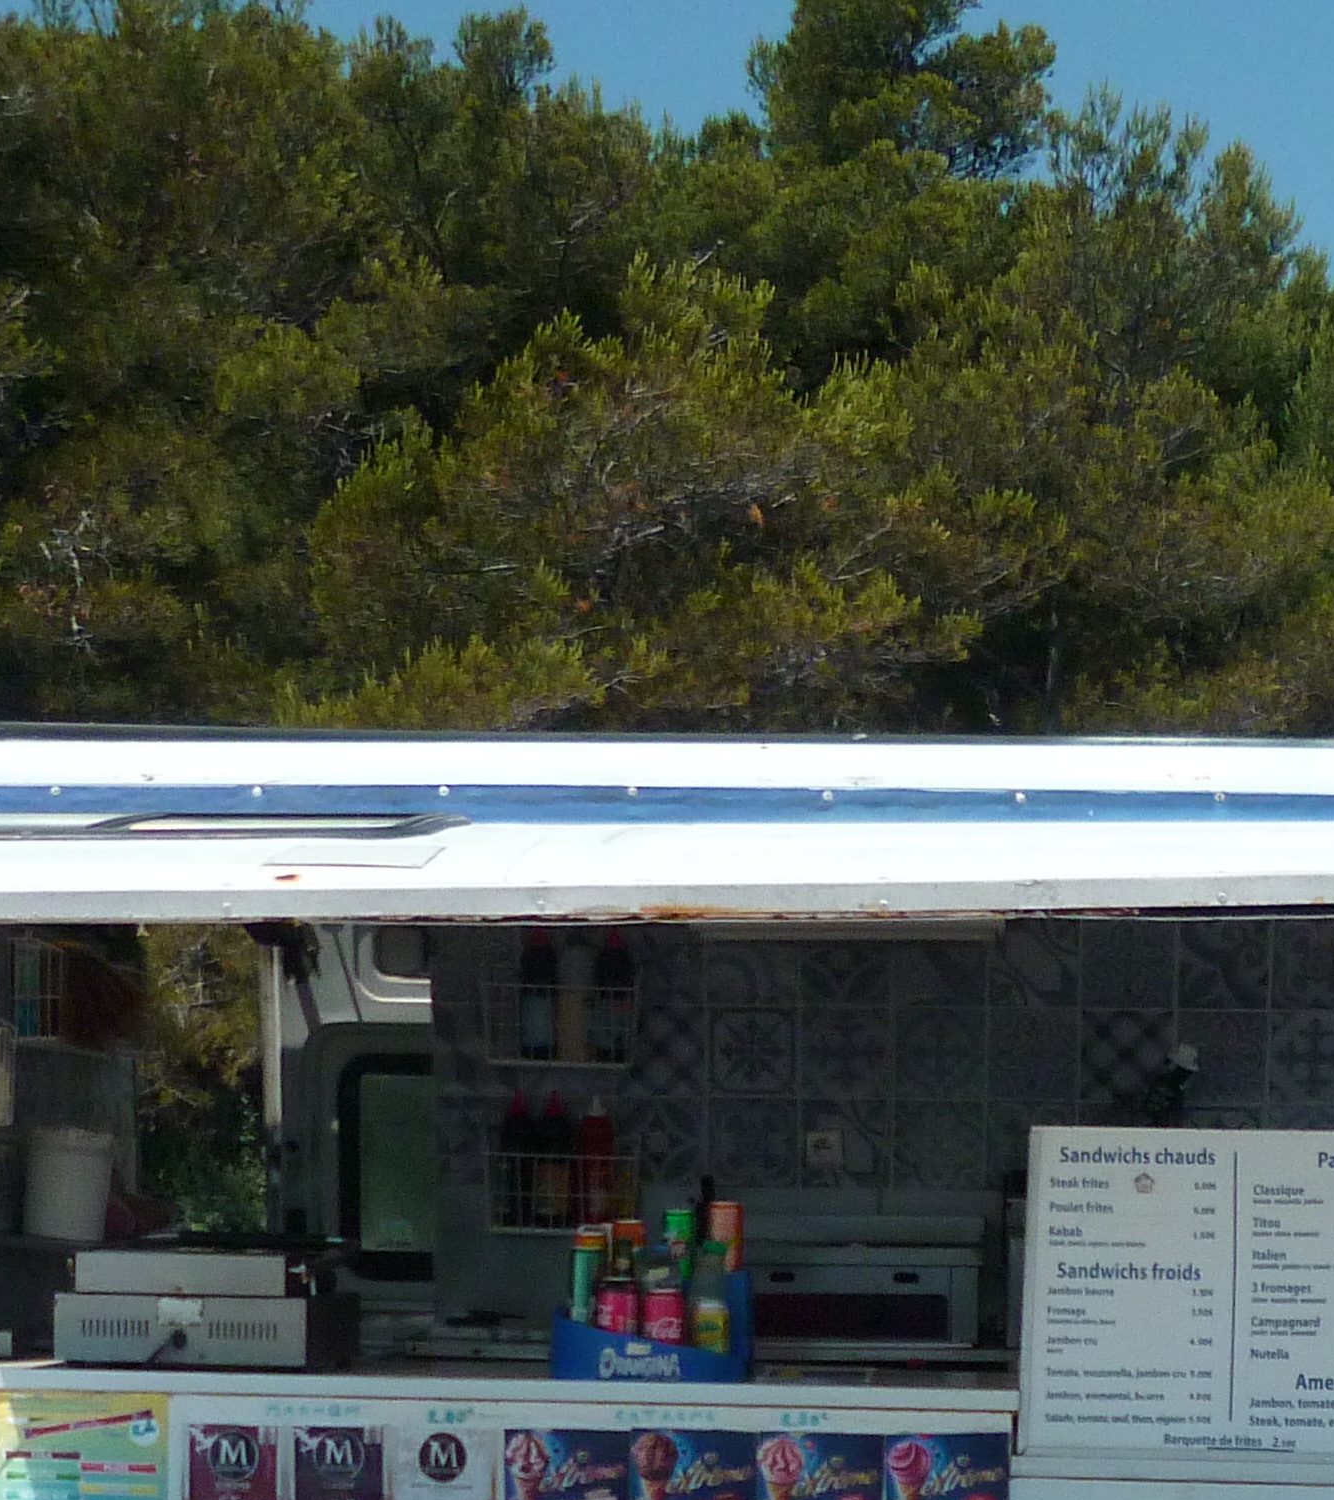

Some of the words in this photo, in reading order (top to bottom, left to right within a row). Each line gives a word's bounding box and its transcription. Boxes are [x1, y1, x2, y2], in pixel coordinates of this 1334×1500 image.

[1059, 1146, 1151, 1165] Sandwichs
[1155, 1146, 1217, 1166] chauds
[1049, 1176, 1080, 1190] Steak
[1082, 1176, 1110, 1190] frites
[1252, 1183, 1305, 1198] Classique
[1049, 1201, 1084, 1213] Poulet
[1086, 1201, 1114, 1213] frites
[1252, 1217, 1282, 1229] Titou
[1252, 1249, 1287, 1261] Italien
[1055, 1261, 1148, 1280] Sandwichs
[1151, 1261, 1202, 1281] froids
[1261, 1282, 1312, 1297] fromages
[1251, 1315, 1322, 1330] Campagnard
[1250, 1348, 1290, 1361] Nutella
[1163, 1433, 1216, 1447] Barquette
[1219, 1434, 1233, 1446] de
[1235, 1434, 1263, 1447] frites
[219, 1439, 248, 1466] M
[324, 1439, 354, 1466] M
[429, 1441, 459, 1468] M
